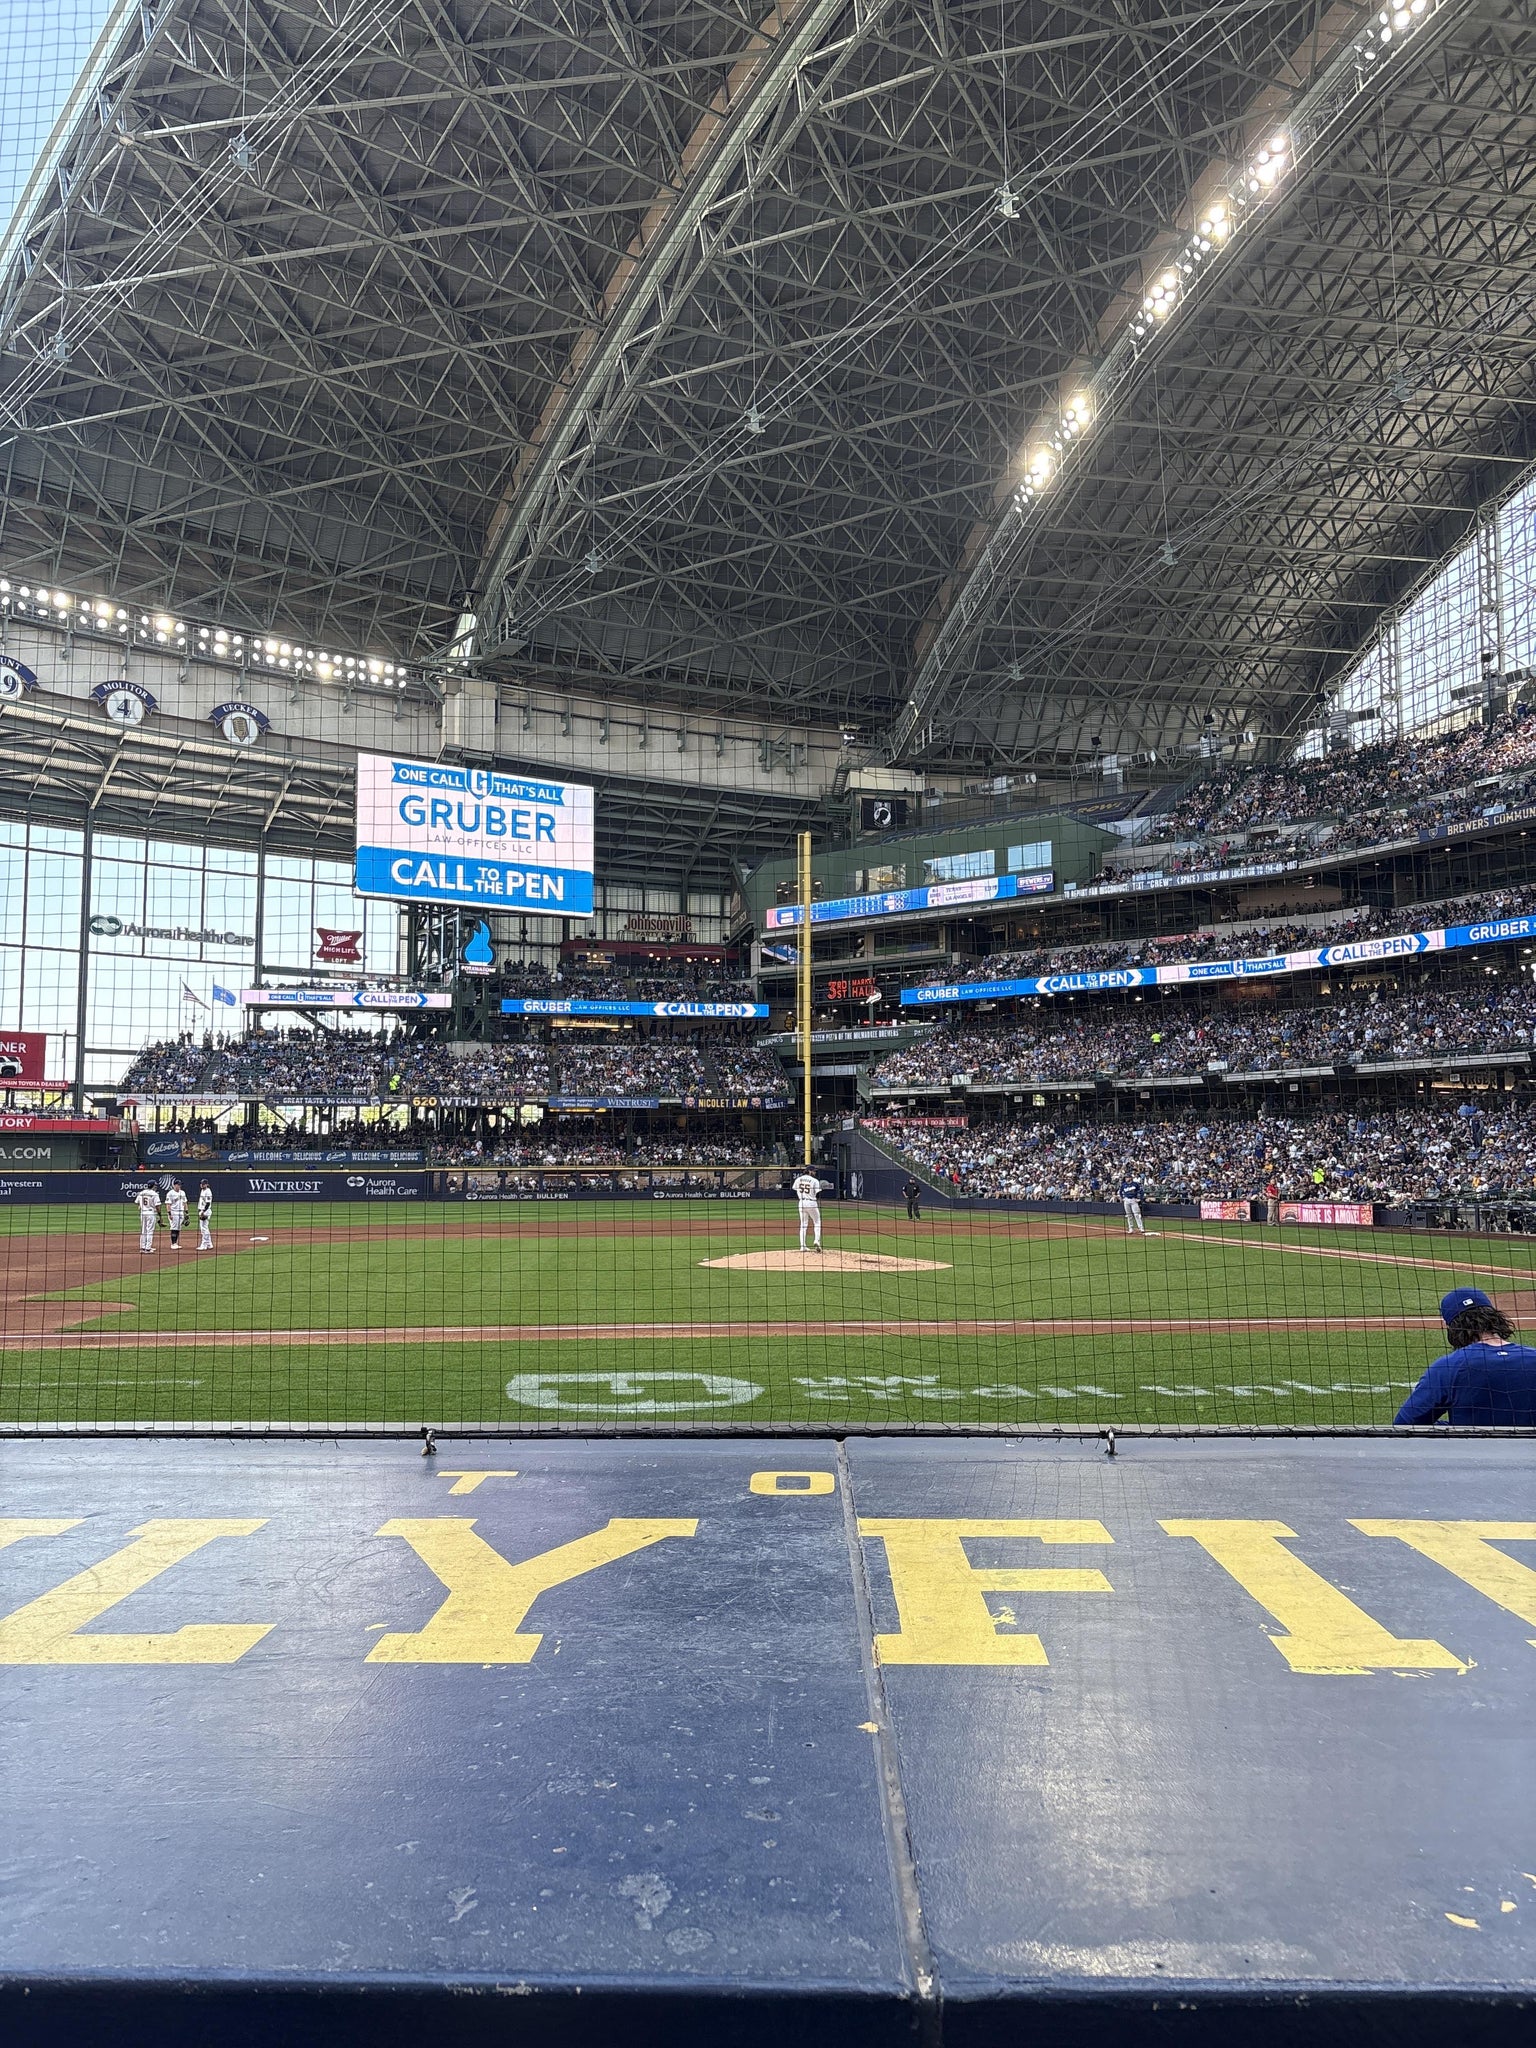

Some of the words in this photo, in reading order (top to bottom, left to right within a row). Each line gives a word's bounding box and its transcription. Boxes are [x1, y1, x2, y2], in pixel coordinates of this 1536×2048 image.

[103, 681, 149, 700] MOLITOR
[117, 699, 132, 718] 4
[222, 704, 259, 717] UECKER
[399, 768, 427, 783] ONE
[430, 772, 463, 788] CALL
[494, 782, 536, 797] THAT'S
[538, 788, 560, 801] ALL
[399, 794, 556, 843] GRUBER
[1447, 817, 1490, 836] BREWERS
[427, 834, 452, 844] LAW
[457, 837, 507, 851] OFFICES
[512, 843, 533, 854] LLC
[391, 858, 473, 892] CALL
[478, 867, 500, 881] TO
[474, 879, 504, 895] THE
[506, 870, 565, 901] PEN
[624, 913, 692, 932] Johnsonville
[126, 922, 173, 939] Aurora
[177, 926, 219, 942] Health
[224, 931, 255, 947] Care
[1469, 919, 1530, 941] GRUBER
[1332, 949, 1367, 962] CALL
[1370, 942, 1380, 950] TO
[1383, 938, 1413, 955] PEN
[1192, 967, 1208, 976] ONE
[1209, 965, 1228, 975] CALL
[1248, 963, 1272, 972] THAT'S
[1272, 960, 1284, 970] ALL
[852, 978, 876, 986] MARKET
[1050, 976, 1086, 990] CALL
[1085, 980, 1099, 988] THE
[1099, 971, 1128, 986] PEN
[852, 985, 875, 998] HALL
[917, 987, 959, 1000] GRUBER
[975, 986, 1000, 994] OFFICES
[363, 995, 388, 1004] CALL
[398, 995, 418, 1004] PEN
[523, 1001, 572, 1012] GRUBER
[668, 1003, 702, 1016] CALL
[716, 1004, 743, 1016] PEN
[0, 1041, 27, 1054] NER
[756, 1035, 784, 1047] PALERMO'S
[412, 1096, 437, 1106] 620
[440, 1096, 479, 1107] WTMJ
[607, 1098, 652, 1107] WINTRUST
[698, 1098, 730, 1108] NICOLET
[732, 1098, 748, 1108] LAW
[0, 1118, 32, 1128] TORY
[147, 1140, 180, 1156] Culver's
[253, 1152, 282, 1161] WELCOME
[352, 1152, 380, 1161] WELCOME
[0, 1180, 43, 1188] hwestern
[120, 1181, 149, 1190] Johnso
[248, 1178, 324, 1192] WINTRUST
[366, 1178, 396, 1187] Aurora
[798, 1183, 811, 1195] 55
[365, 1186, 395, 1196] Health
[397, 1186, 418, 1196] Care
[142, 1197, 149, 1206] 6
[1302, 1209, 1321, 1223] MORE
[1324, 1209, 1332, 1223] IS
[0, 1518, 699, 1663] LY
